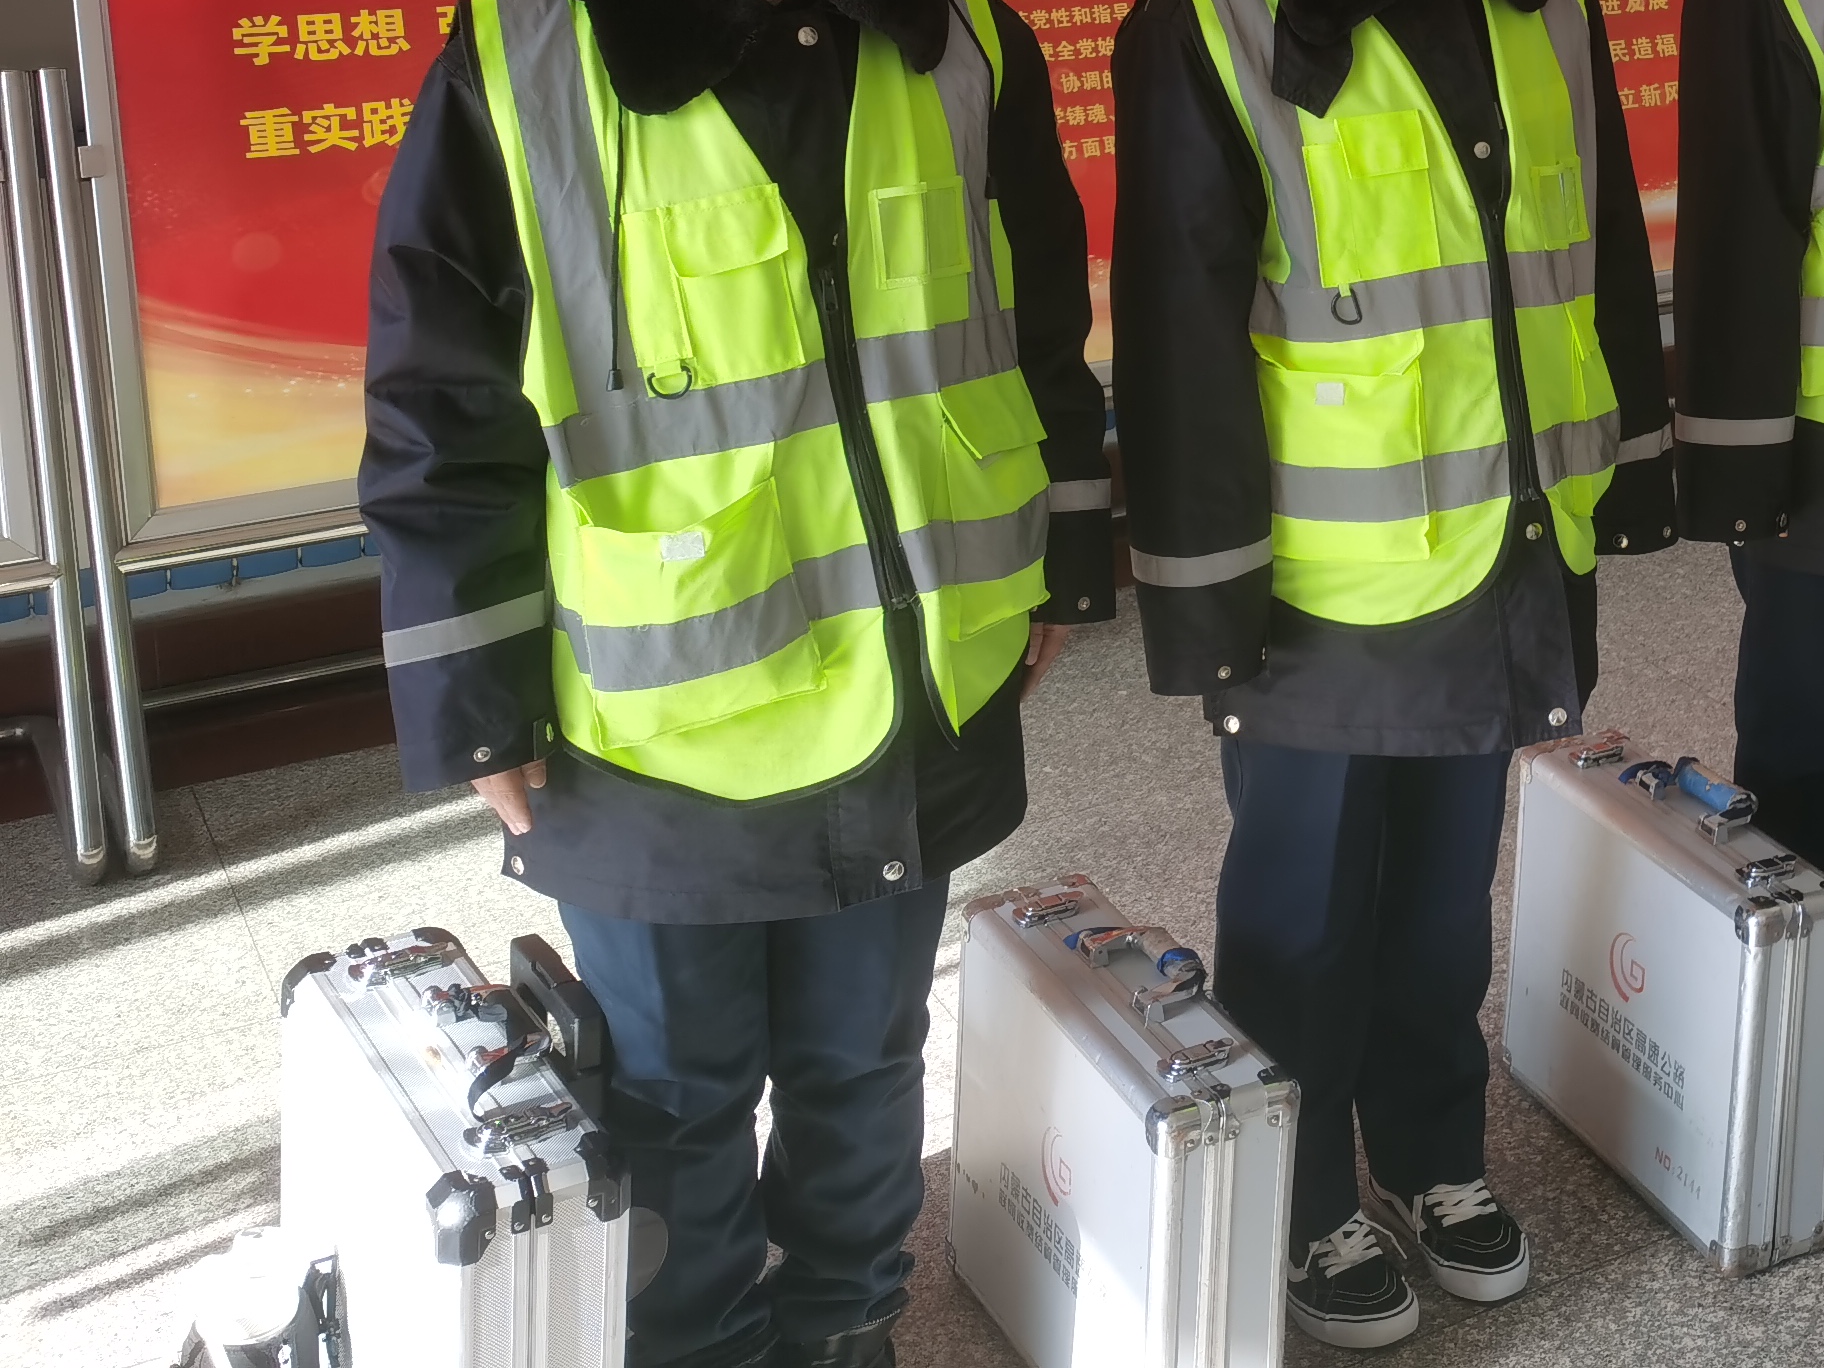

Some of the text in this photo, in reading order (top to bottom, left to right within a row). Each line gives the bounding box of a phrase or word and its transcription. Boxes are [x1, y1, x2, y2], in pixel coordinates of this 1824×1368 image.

[232, 8, 411, 65] 学思想
[1608, 34, 1678, 63] 民造福
[240, 98, 414, 158] 重实践
[1561, 967, 1686, 1088] 内蒙古自治区高速公路
